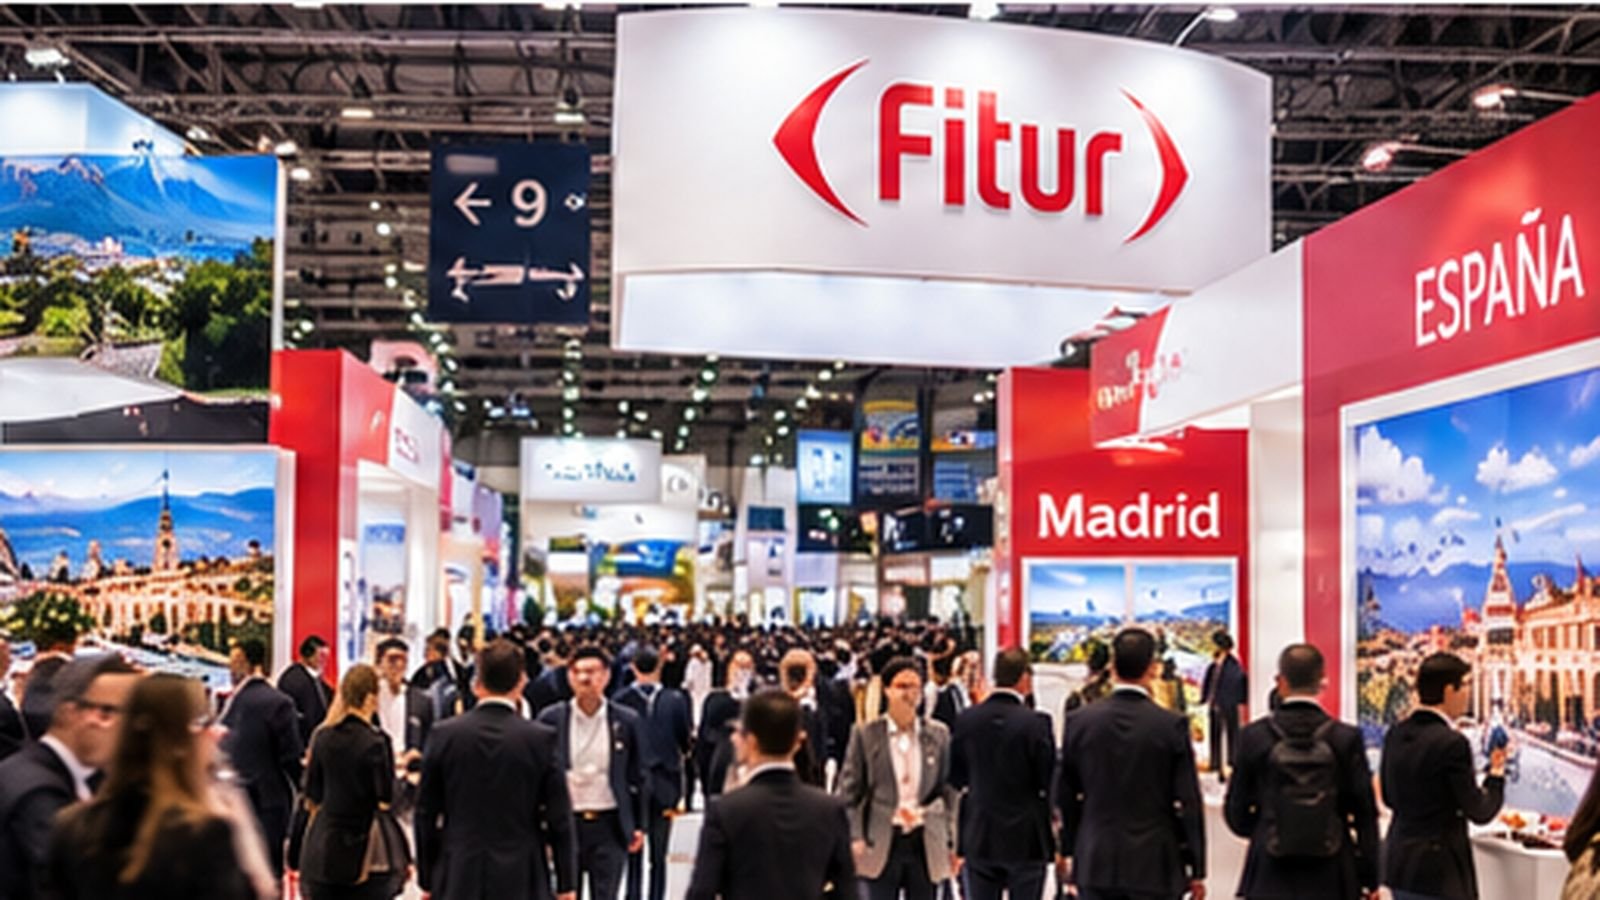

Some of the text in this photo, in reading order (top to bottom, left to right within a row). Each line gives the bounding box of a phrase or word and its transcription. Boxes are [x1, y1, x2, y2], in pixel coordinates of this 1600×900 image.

[879, 82, 1122, 216] Fitur
[512, 179, 547, 227] 9
[1415, 207, 1585, 347] ESPAÑA
[1038, 492, 1220, 539] Madrid
